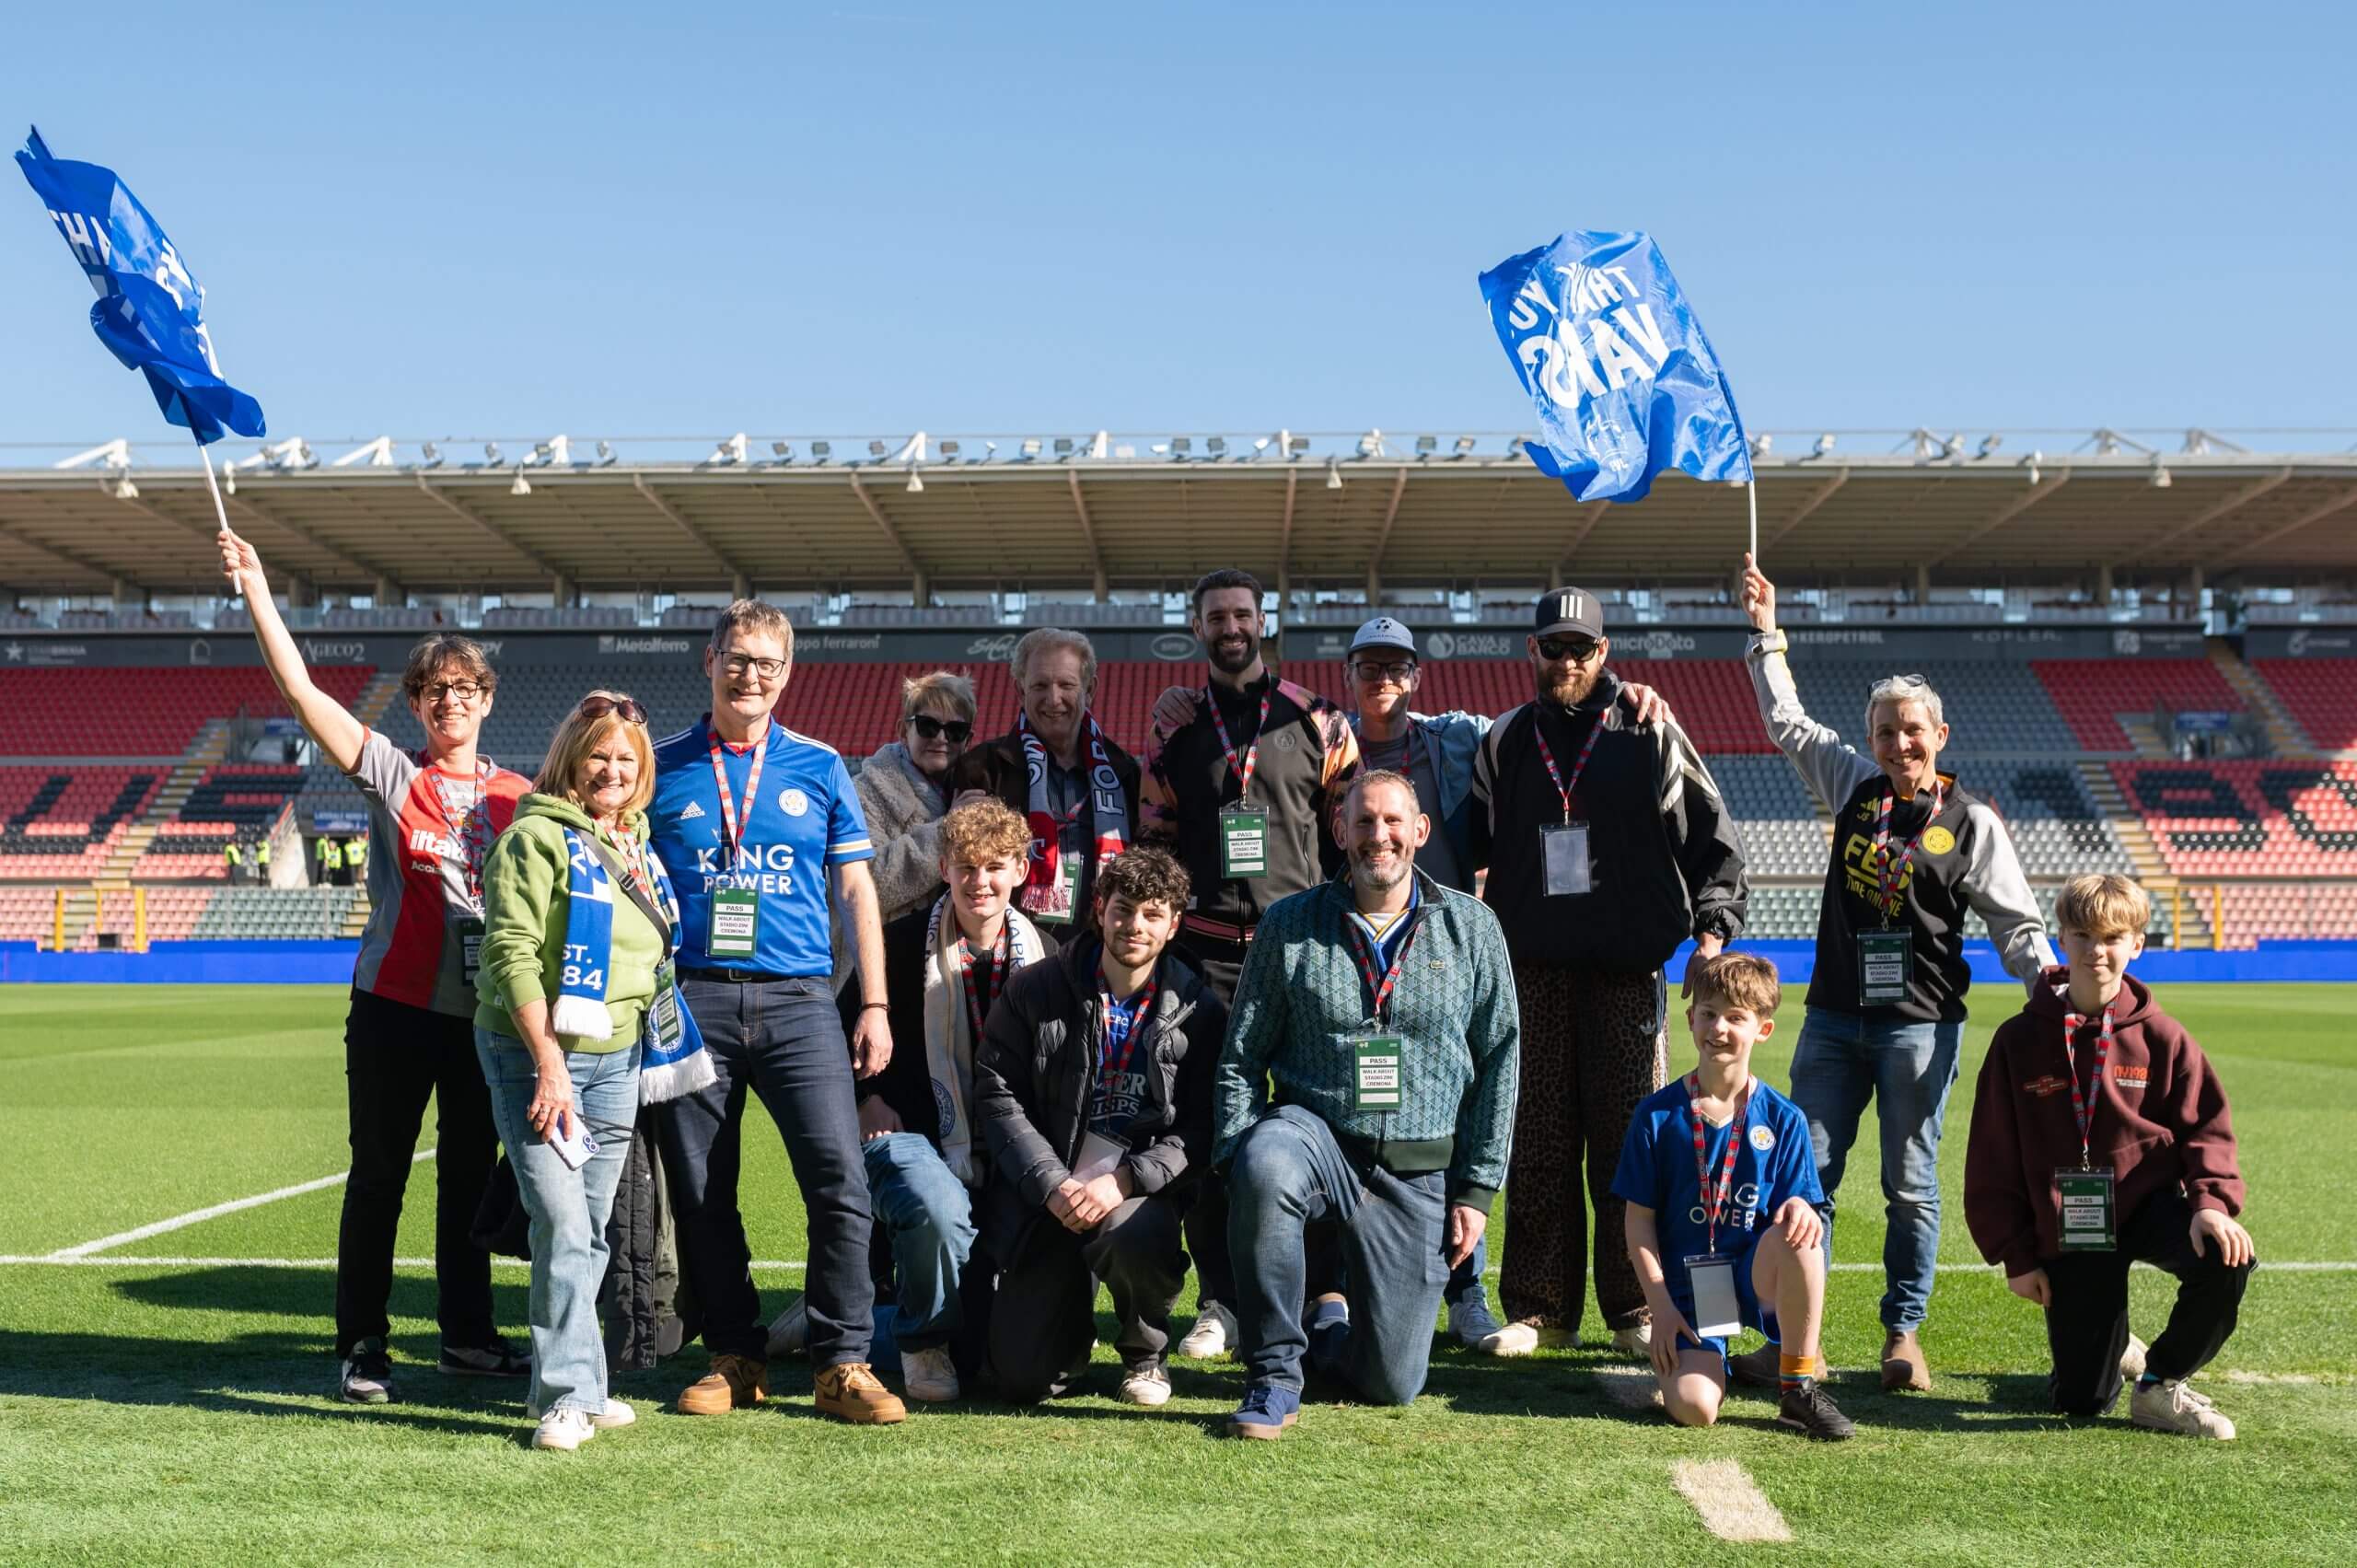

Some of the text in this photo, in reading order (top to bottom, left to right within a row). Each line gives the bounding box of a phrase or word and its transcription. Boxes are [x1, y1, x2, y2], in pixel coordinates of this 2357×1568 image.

[696, 843, 795, 873] KING
[702, 873, 792, 895] POWER
[562, 943, 593, 964] ST.
[561, 965, 604, 991] 84
[1689, 1206, 1757, 1232] OWER
